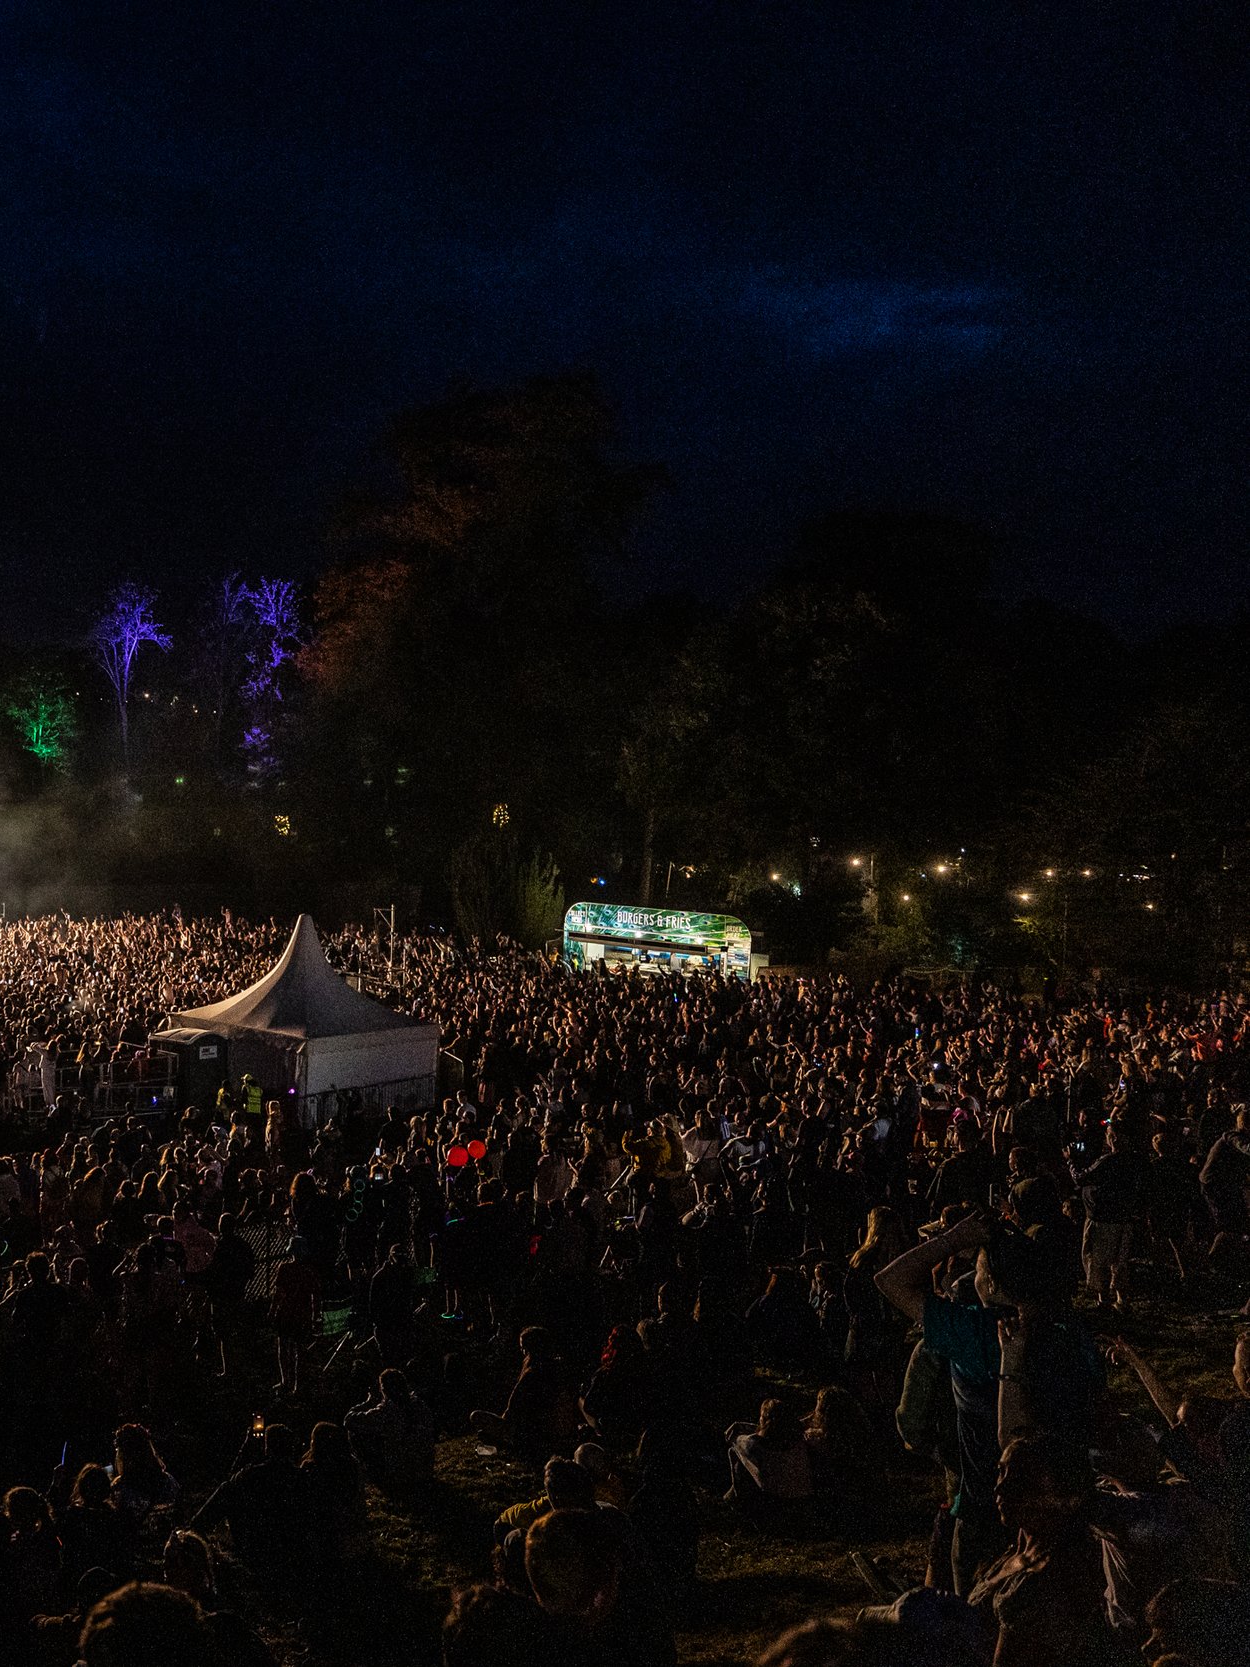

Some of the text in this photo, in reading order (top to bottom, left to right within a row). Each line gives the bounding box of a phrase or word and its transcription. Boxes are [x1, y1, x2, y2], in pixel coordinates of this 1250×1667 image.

[617, 911, 691, 930] BURGERS & FRIES
